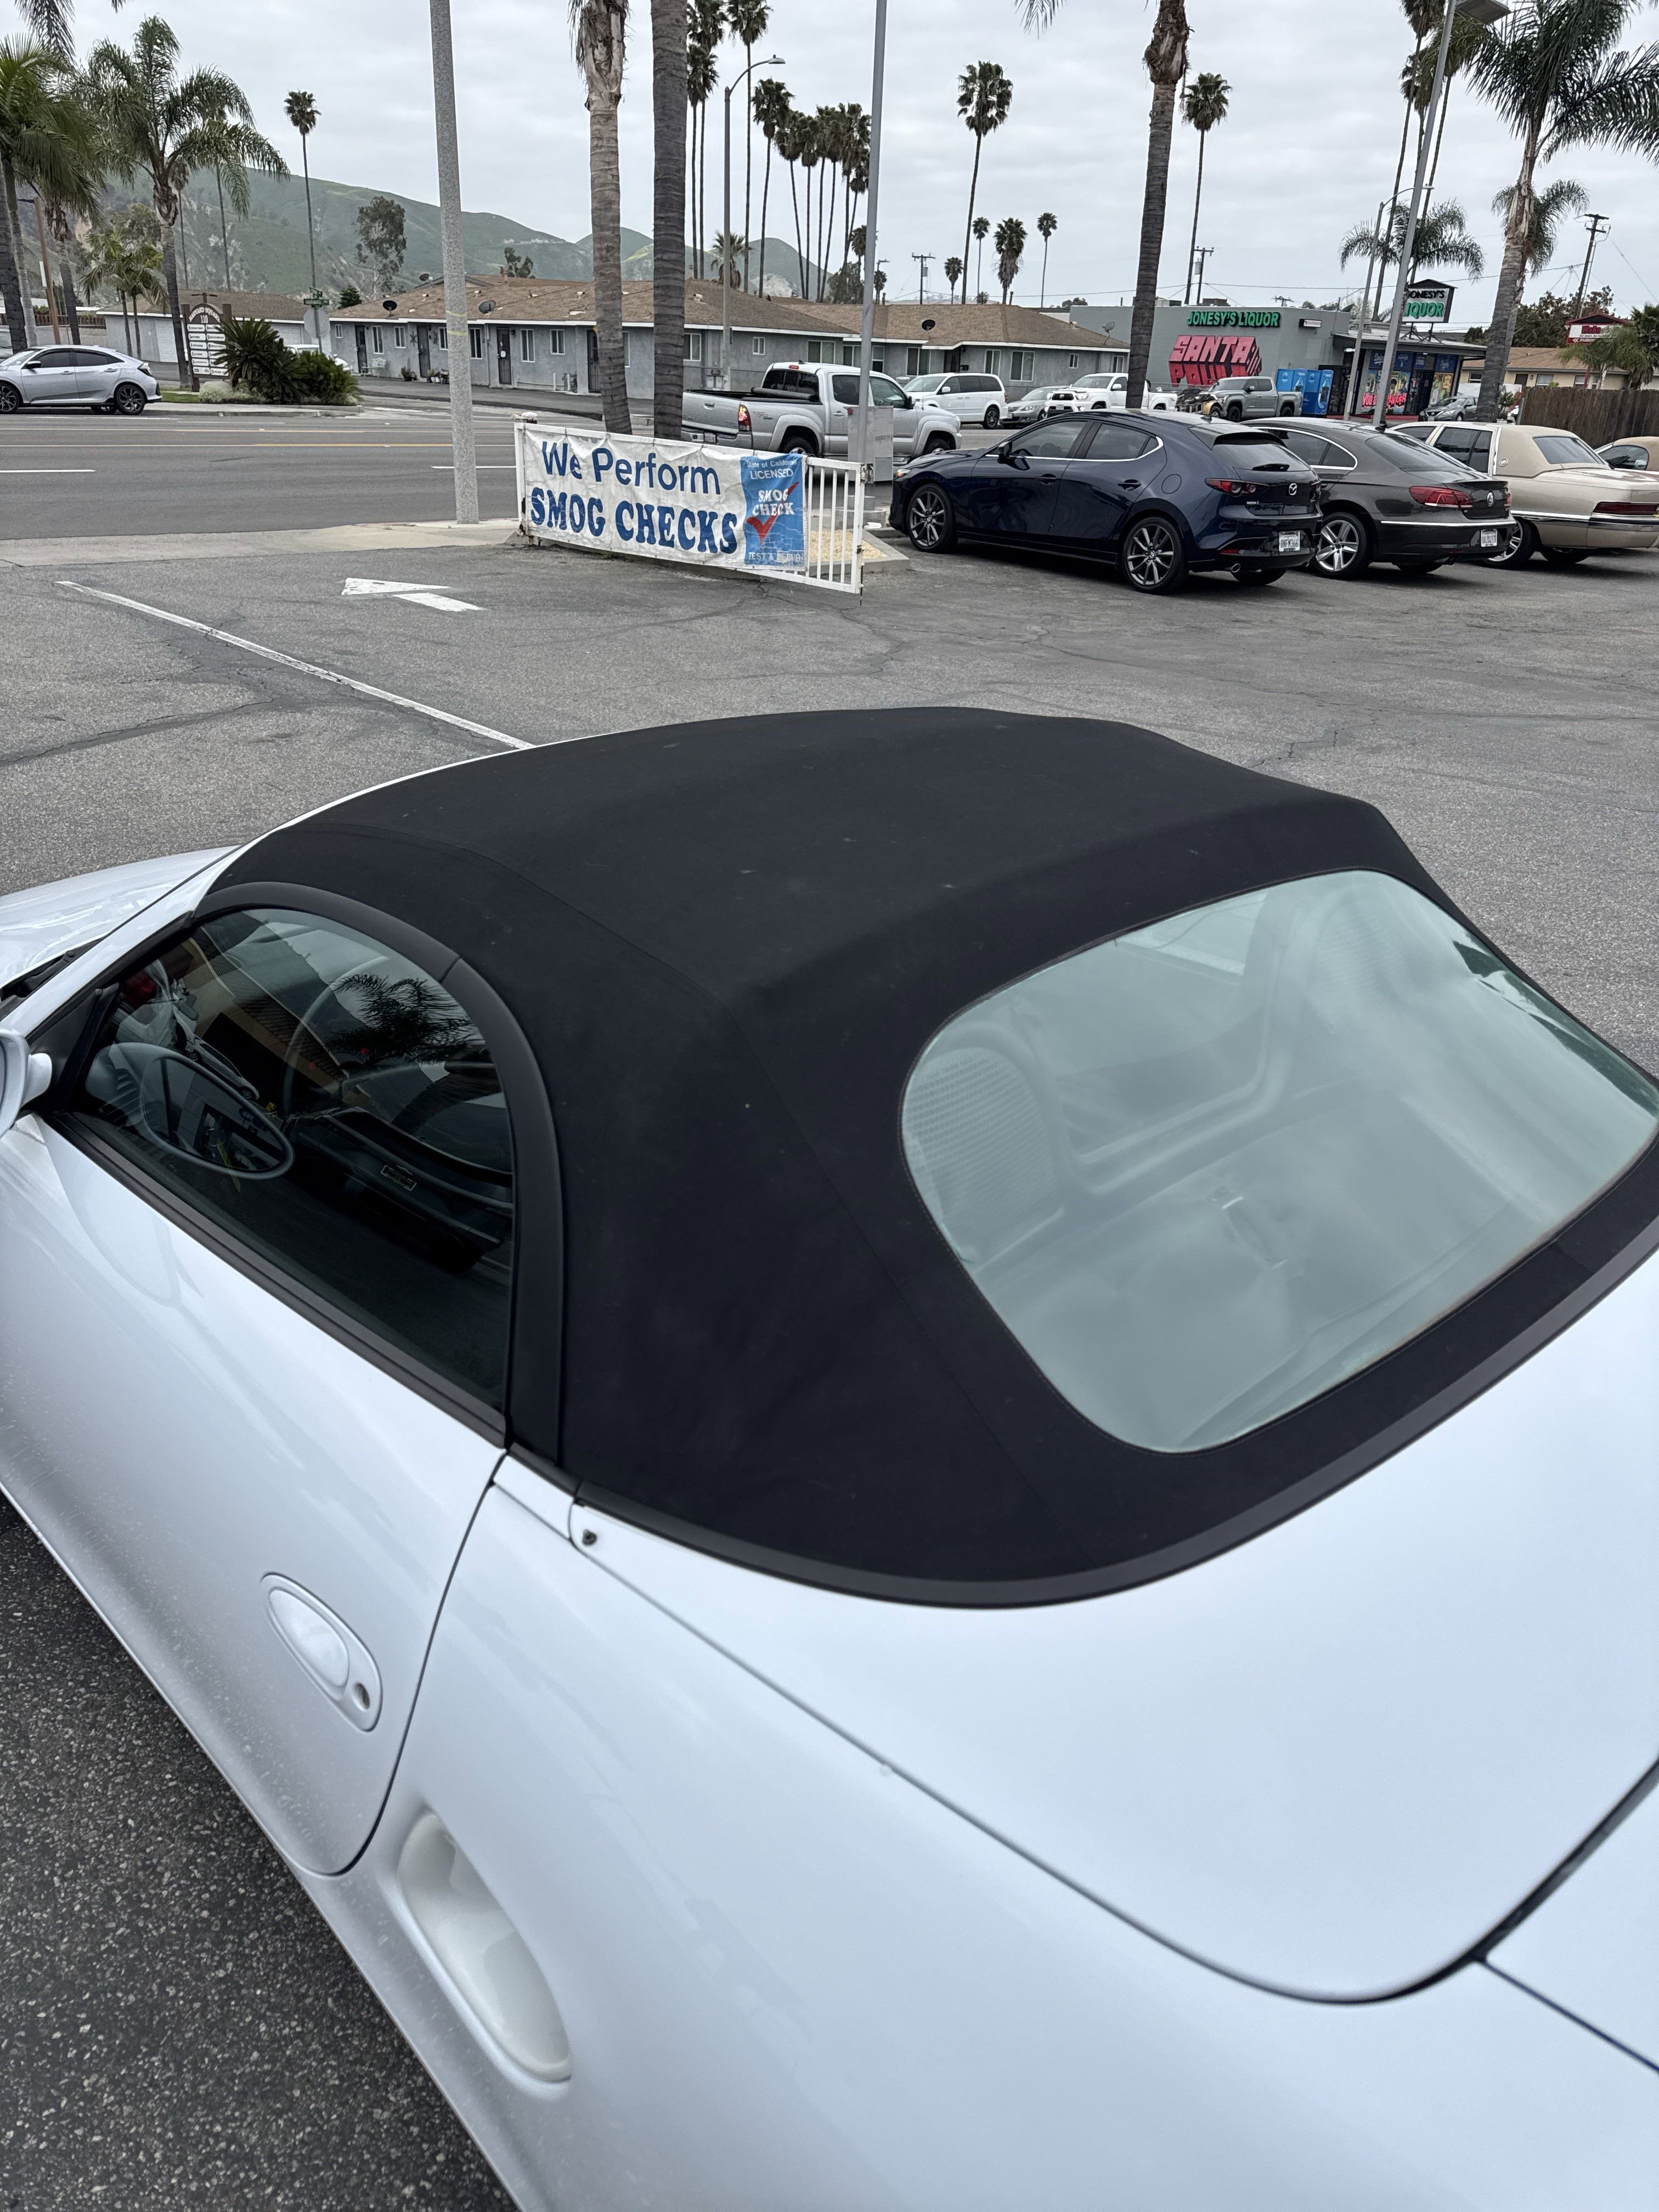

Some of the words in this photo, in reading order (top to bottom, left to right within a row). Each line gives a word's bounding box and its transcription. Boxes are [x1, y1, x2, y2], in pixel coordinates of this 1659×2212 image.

[200, 314, 208, 324] 110
[1187, 311, 1237, 327] JONESY'S
[1238, 312, 1280, 328] LIQUOR
[1169, 335, 1255, 363] SANTA
[543, 441, 582, 479] We
[592, 447, 721, 495] Perform
[747, 459, 760, 468] State
[751, 468, 793, 479] LICENSED
[752, 502, 795, 516] CHECK
[531, 487, 606, 537] SMOG
[615, 500, 738, 554] CHECKS
[748, 552, 765, 560] TEST
